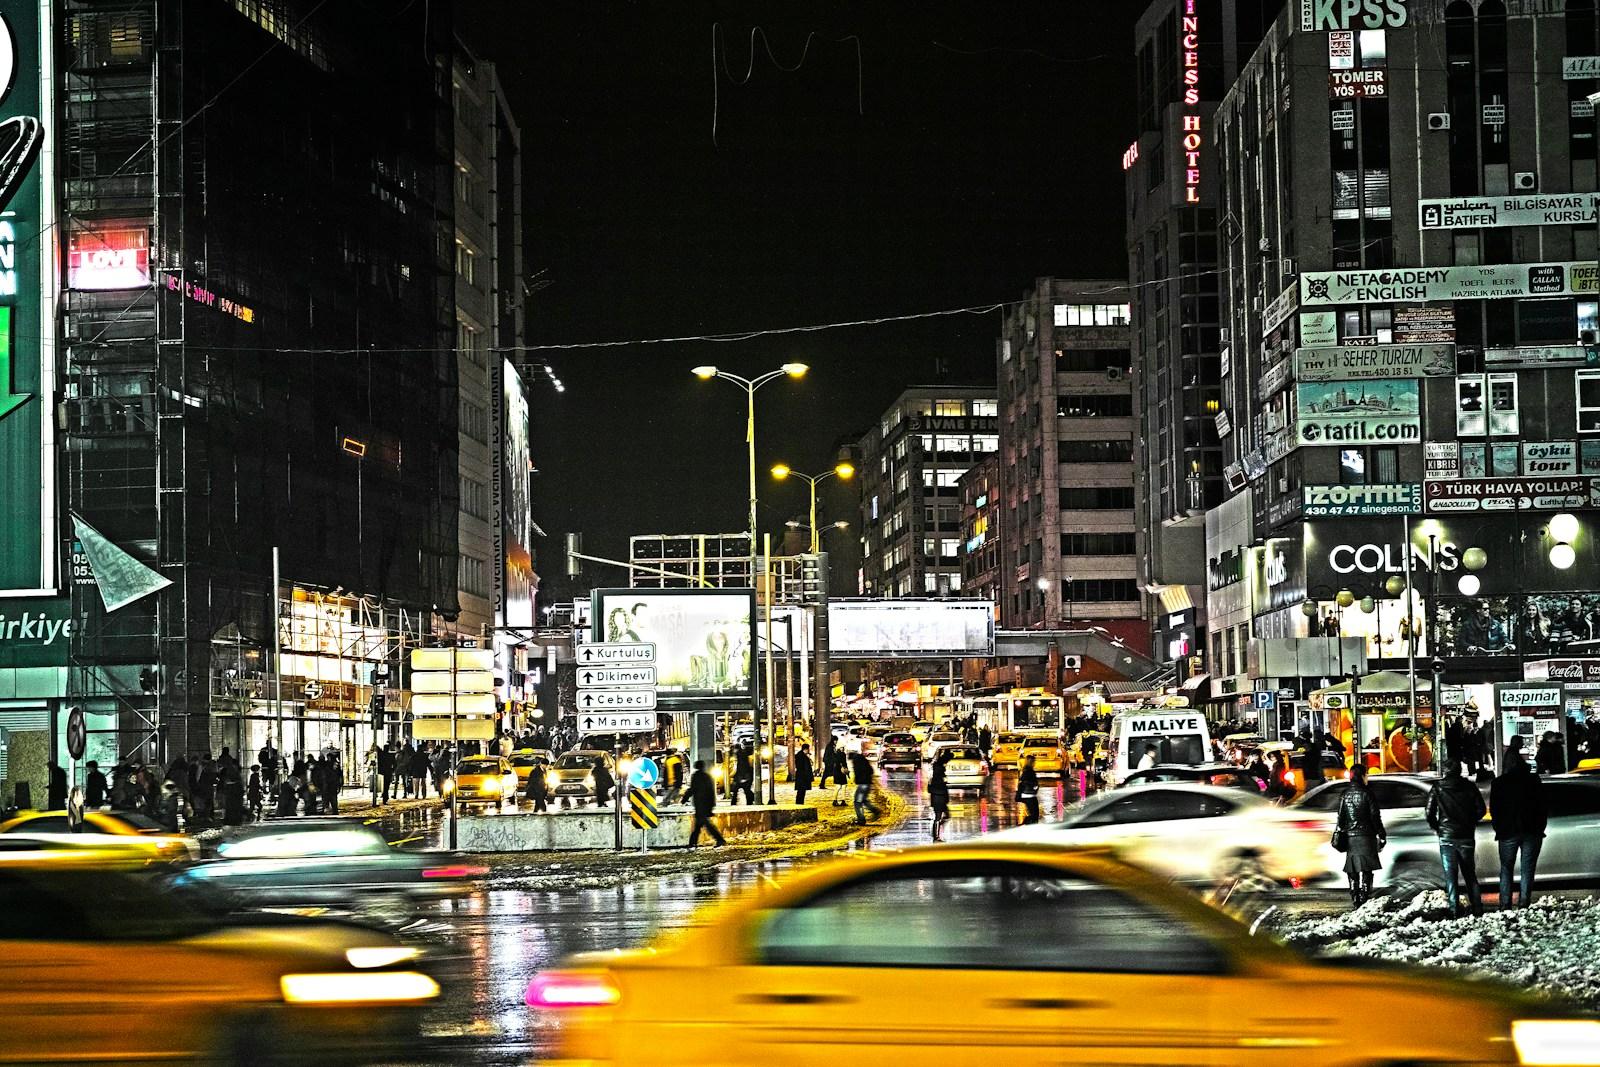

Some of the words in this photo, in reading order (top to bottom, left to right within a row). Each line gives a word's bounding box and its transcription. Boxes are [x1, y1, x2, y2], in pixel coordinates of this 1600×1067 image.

[1315, 0, 1407, 30] KPSS
[1333, 70, 1384, 83] TÖMER
[1333, 84, 1354, 97] YÖS
[1363, 84, 1384, 95] YDS
[1183, 116, 1201, 202] HOTEL
[1538, 267, 1554, 275] with
[1337, 270, 1450, 287] NETACADEMY
[1532, 276, 1560, 284] CALLAN
[1357, 286, 1426, 301] ENGLISH
[1533, 285, 1560, 293] Method
[1344, 338, 1376, 346] KAT.4
[1381, 347, 1423, 366] TURİZM
[1304, 361, 1326, 369] THY
[1324, 421, 1419, 440] tatil.com
[1528, 445, 1570, 458] öykü
[1427, 459, 1457, 469] KIBRIS
[1528, 460, 1571, 472] tour
[1446, 482, 1482, 495] TÜRK
[1485, 483, 1524, 495] HAVA
[1305, 507, 1327, 515] 430
[1329, 506, 1343, 515] 47
[1345, 506, 1360, 514] 47
[1329, 543, 1459, 573] COLIN'S
[597, 648, 651, 659] Kurtuluş
[597, 670, 651, 681] Dikimevi
[597, 693, 648, 704] Cebeci
[1259, 693, 1269, 706] P
[598, 716, 651, 727] Mamak
[1132, 718, 1197, 732] MALiYE
